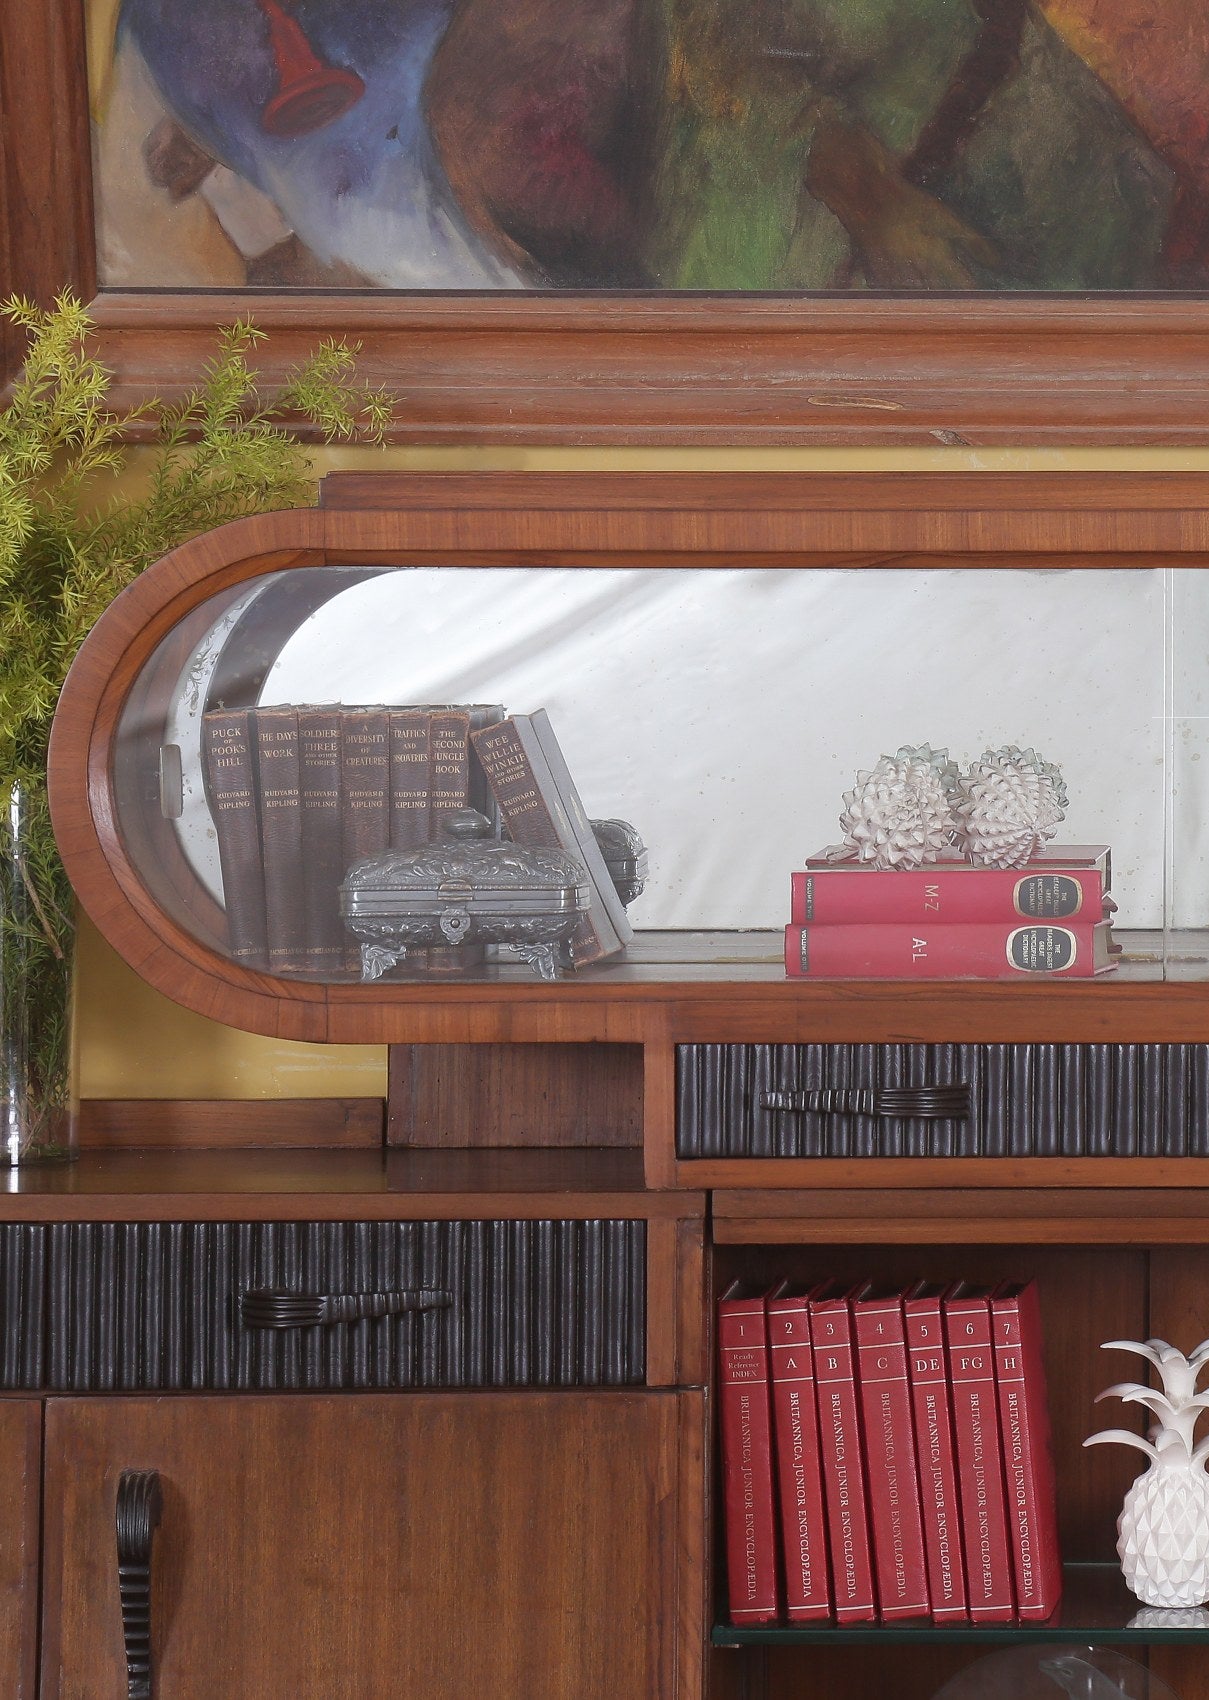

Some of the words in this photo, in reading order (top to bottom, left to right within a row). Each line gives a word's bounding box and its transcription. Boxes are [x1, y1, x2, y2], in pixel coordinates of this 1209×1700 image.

[212, 728, 242, 738] PUCK
[345, 734, 386, 744] DIVERSITY
[393, 729, 426, 738] TRAFFICS
[440, 730, 456, 738] THE
[304, 742, 338, 751] THREE
[432, 740, 465, 749] SECOND
[485, 735, 509, 749] WEE
[211, 744, 246, 756] POOK'S
[263, 748, 294, 759] WORK
[483, 742, 521, 763] WILLIE
[217, 757, 244, 767] HILL
[346, 757, 386, 767] CREATURES
[434, 752, 465, 761] JUNGLE
[486, 752, 526, 774] WINKIE
[435, 765, 461, 774] BOOK
[497, 770, 526, 786] STORIES
[216, 790, 250, 800] RUDYARD
[264, 789, 299, 798] RUDYARD
[304, 790, 338, 798] RUDYARD
[349, 791, 384, 799] RUDYARD
[393, 791, 427, 799] RUDYARD
[431, 791, 465, 799] RUDYARD
[503, 790, 536, 807] RUDYARD
[219, 800, 250, 810] KIPLING
[266, 800, 298, 808] KIPLING
[351, 800, 383, 808] KIPLING
[395, 801, 426, 809] KIPLING
[432, 801, 463, 809] KIPLING
[508, 800, 538, 817] KIPLING
[925, 885, 939, 911] M-Z
[912, 937, 928, 963] A-L
[739, 1326, 744, 1337] 1
[785, 1323, 793, 1334] 2
[826, 1324, 834, 1335] 3
[876, 1323, 884, 1335] 4
[921, 1325, 928, 1337] 5
[966, 1322, 974, 1335] 6
[1003, 1323, 1011, 1335] 7
[733, 1353, 754, 1361] Ready
[786, 1357, 797, 1369] A
[877, 1357, 888, 1369] C
[961, 1356, 983, 1370] FG
[1004, 1357, 1016, 1369] H
[828, 1357, 838, 1370] B
[732, 1370, 757, 1378] INDEX
[741, 1395, 751, 1463] BRITANNICA
[790, 1392, 802, 1460] BRITANNICA
[831, 1393, 844, 1461] BRITANNICA
[881, 1393, 895, 1461] BRITANNICA
[926, 1395, 940, 1463] BRITANNICA
[970, 1393, 983, 1462] BRITANNICA
[1008, 1393, 1022, 1461] BRITANNICA
[741, 1466, 753, 1509] JUNIOR
[793, 1463, 806, 1506] JUNIOR
[835, 1464, 848, 1507] JUNIOR
[885, 1464, 898, 1506] JUNIOR
[930, 1466, 944, 1508] JUNIOR
[973, 1464, 987, 1507] JUNIOR
[1012, 1464, 1026, 1506] JUNIOR
[745, 1513, 757, 1601] ENCYCLOPÆDIA
[798, 1510, 812, 1598] ENCYCLOPÆDIA
[841, 1511, 856, 1598] ENCYCLOPÆDIA
[891, 1510, 906, 1598] ENCYCLOPÆDIA
[937, 1512, 952, 1600] ENCYCLOPÆDIA
[979, 1511, 993, 1599] ENCYCLOPÆDIA
[1018, 1511, 1033, 1598] ENCYCLOPÆDIA
